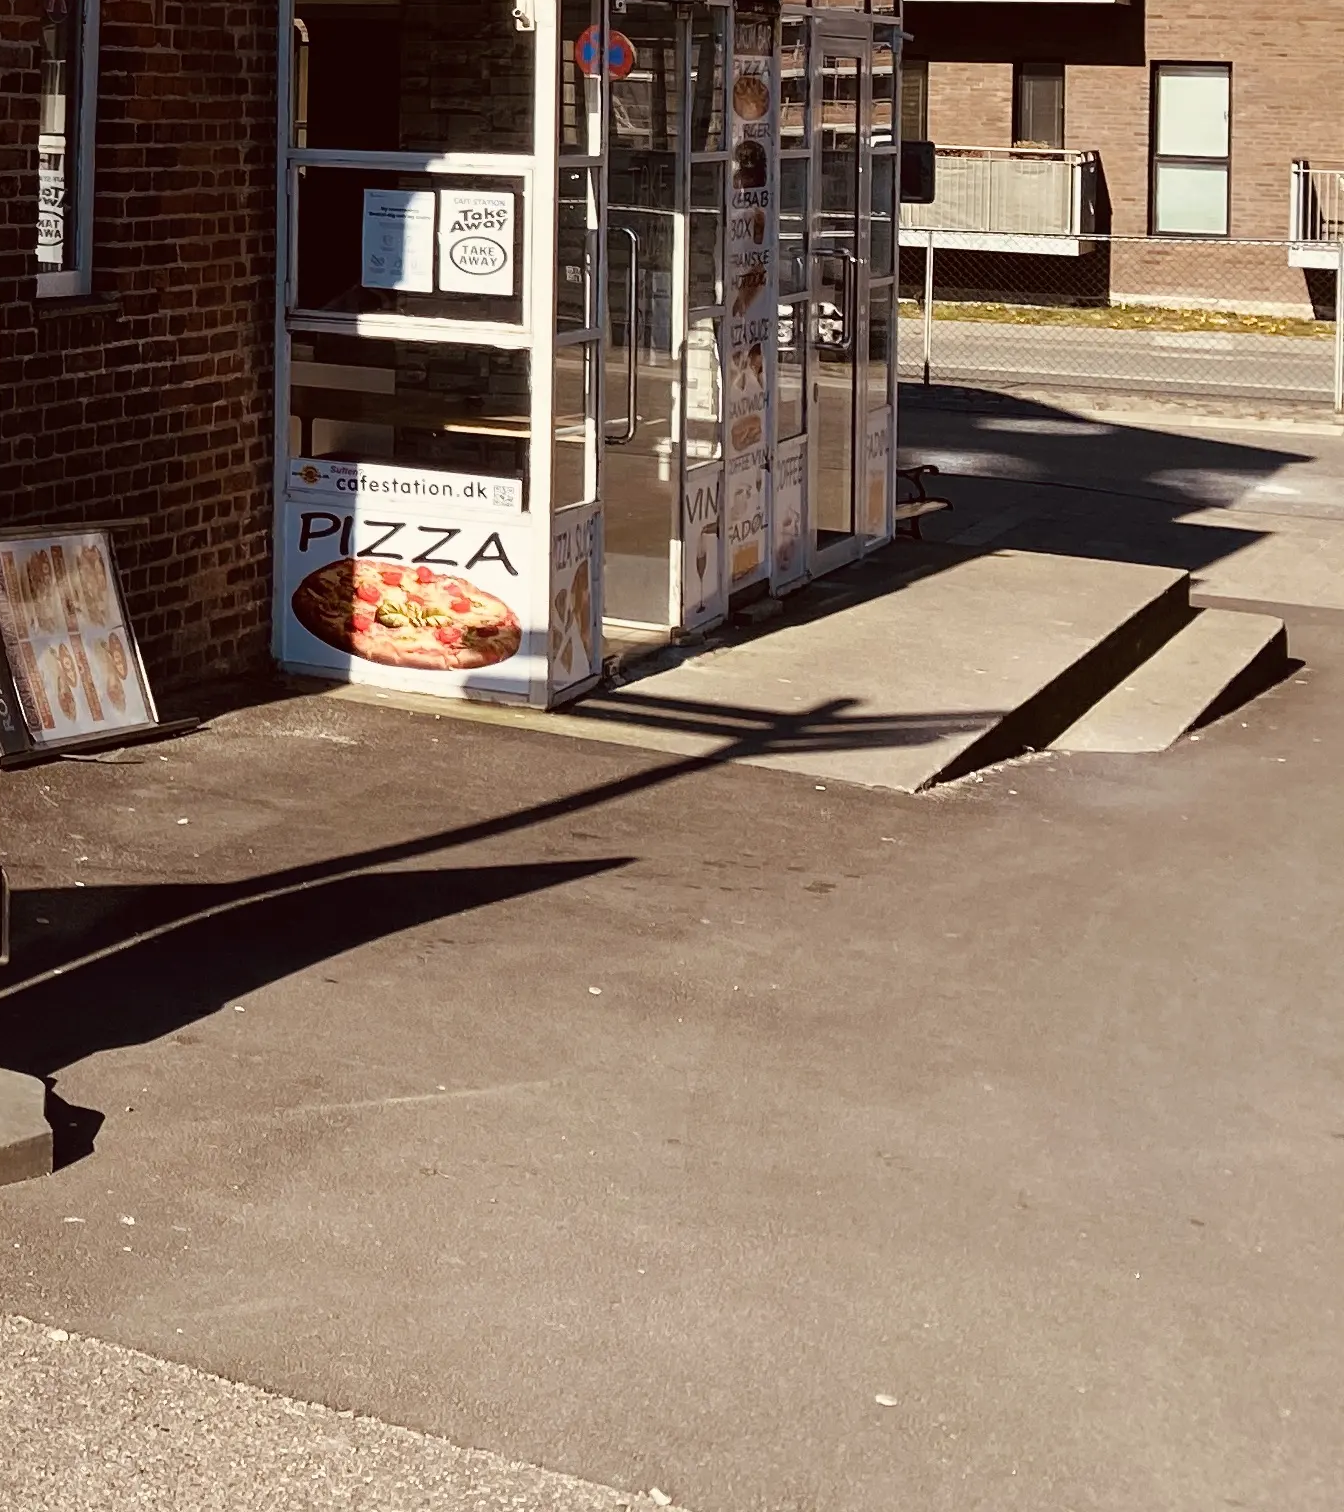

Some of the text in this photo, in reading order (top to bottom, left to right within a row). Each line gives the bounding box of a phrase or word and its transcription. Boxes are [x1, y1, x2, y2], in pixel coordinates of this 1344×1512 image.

[458, 208, 508, 222] Take
[450, 218, 508, 233] Away
[462, 245, 495, 257] TAKE
[459, 255, 498, 266] AWAY
[336, 475, 487, 499] cafestation.dk
[686, 482, 719, 524] VIN
[298, 511, 519, 576] PIZZA
